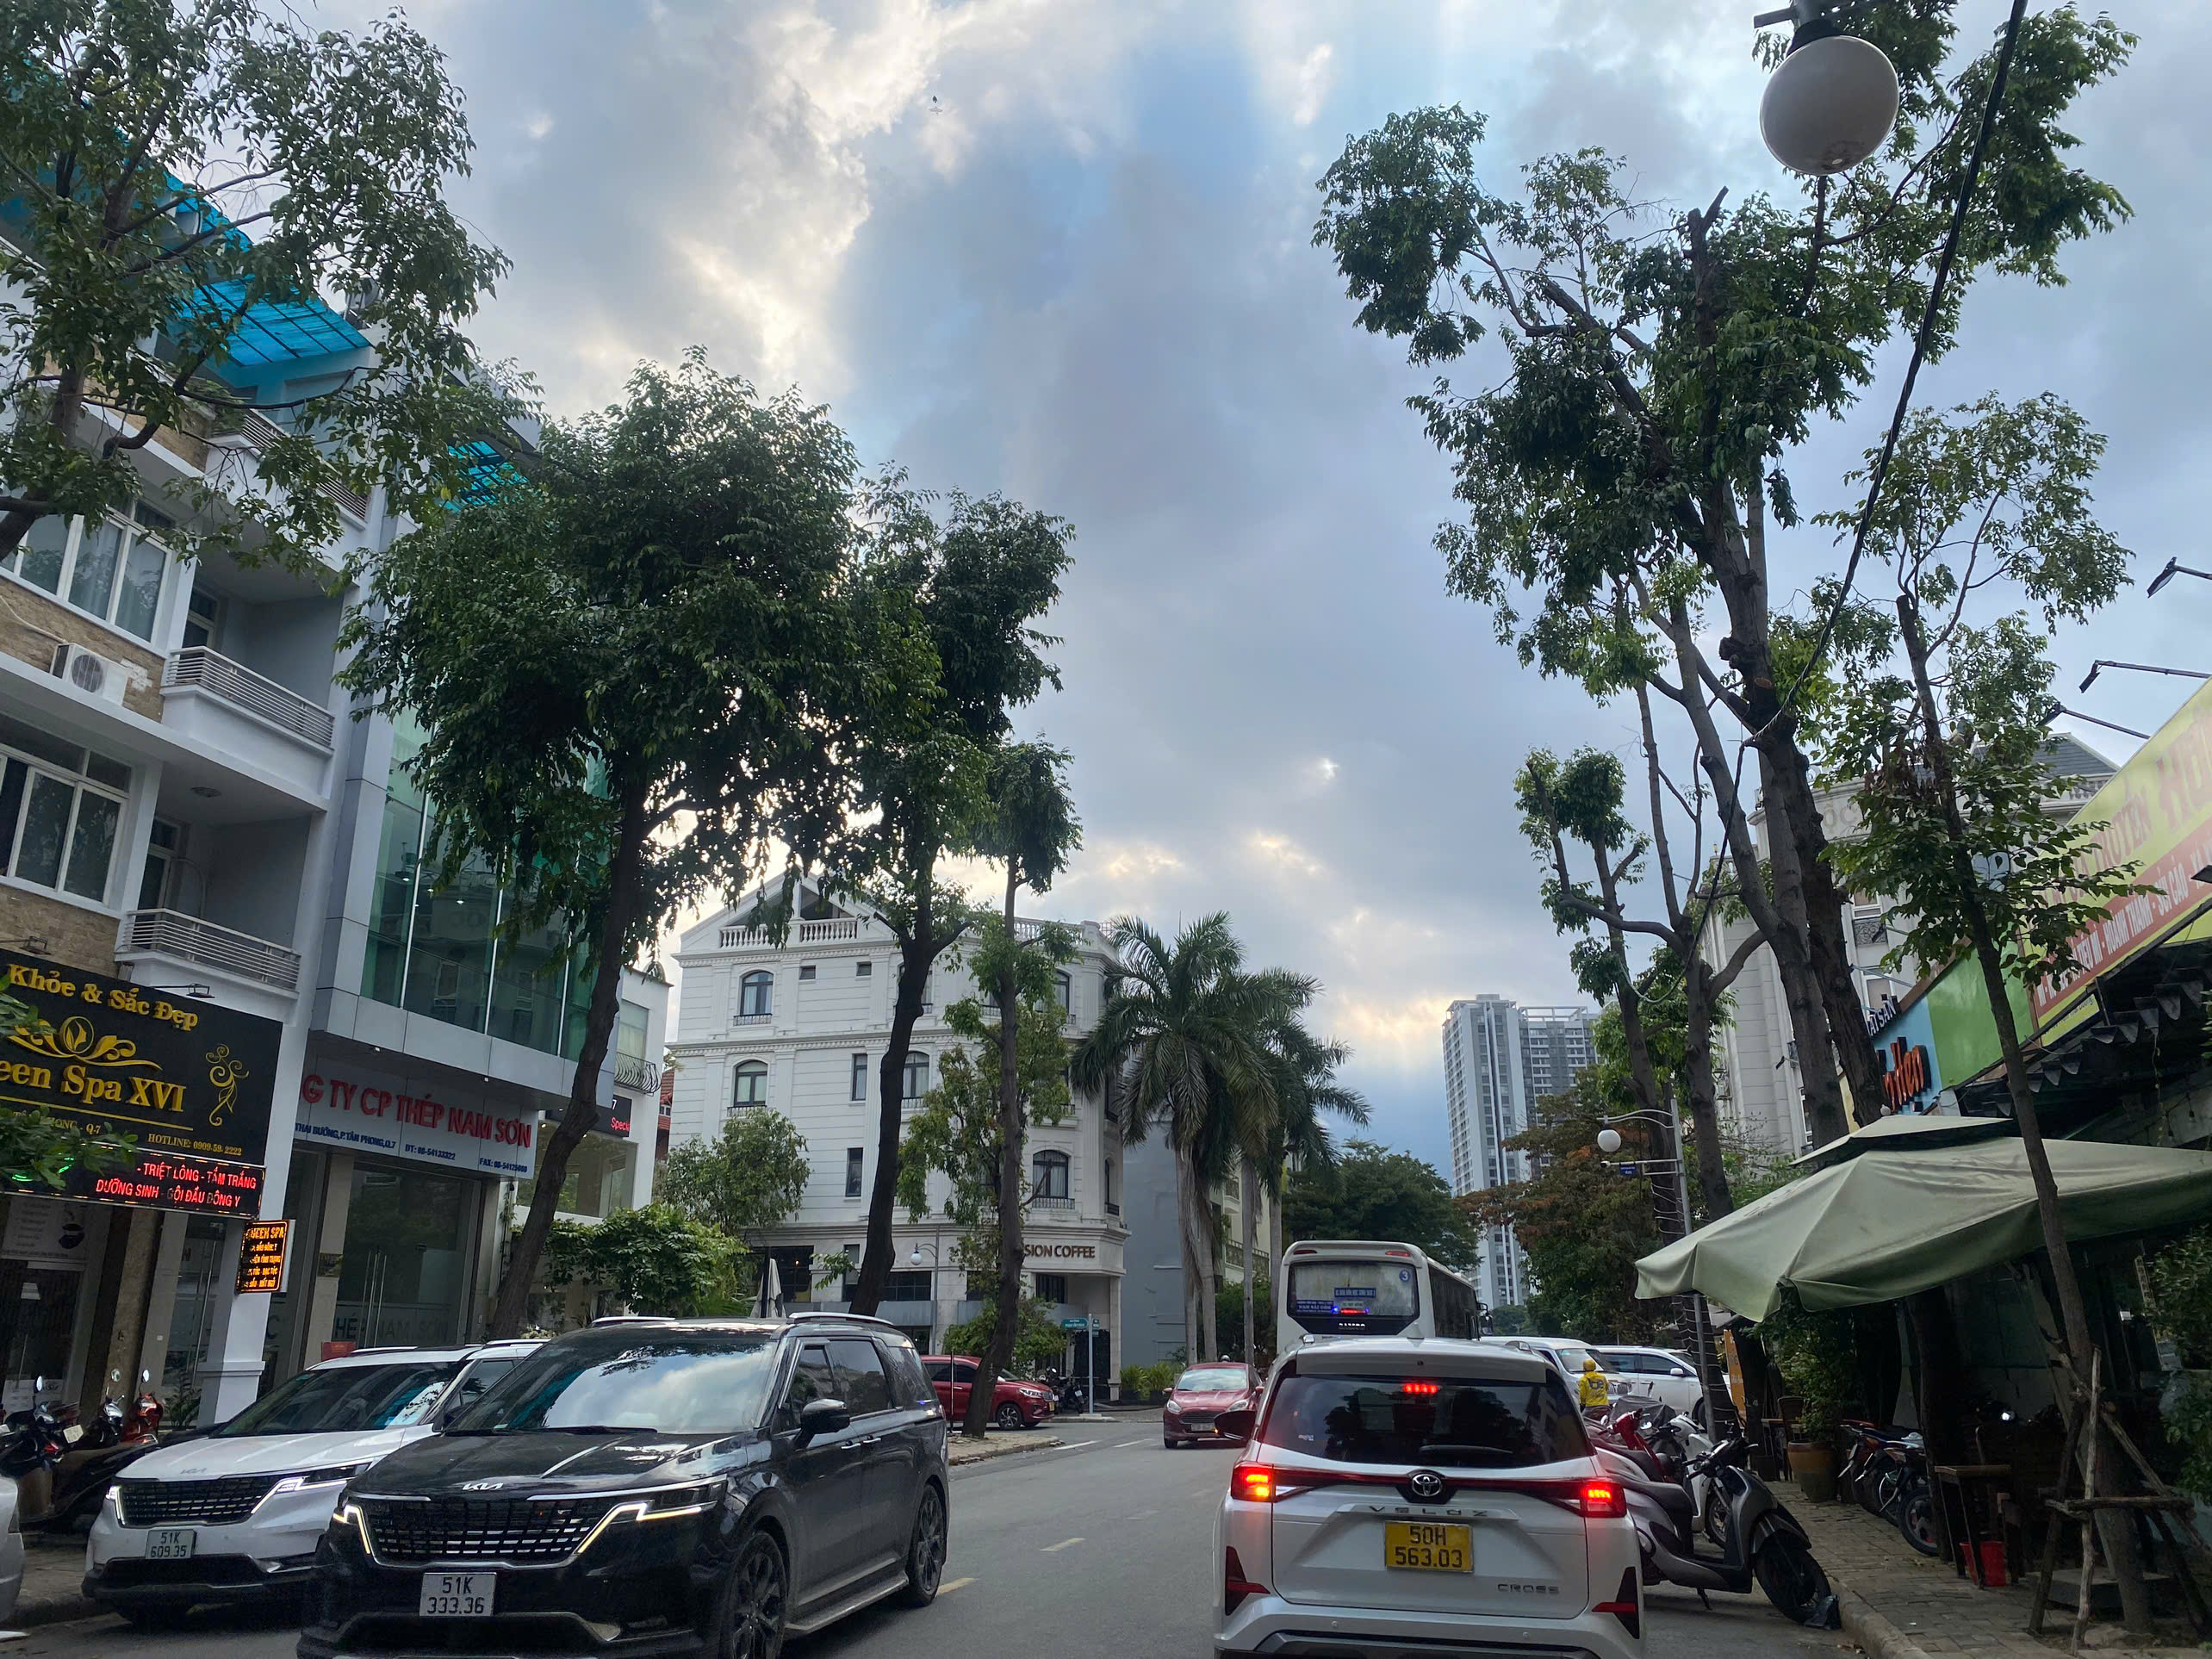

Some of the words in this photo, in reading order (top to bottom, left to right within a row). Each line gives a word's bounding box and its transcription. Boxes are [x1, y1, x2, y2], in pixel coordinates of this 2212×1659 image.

[7, 963, 76, 997] Khỏe
[83, 983, 102, 1003] &
[108, 988, 150, 1015] Sắc
[152, 1001, 198, 1032] Đẹp
[61, 1064, 121, 1105] Spa
[127, 1077, 187, 1112] XVI
[331, 1078, 358, 1111] TY
[360, 1087, 391, 1118] CP
[396, 1093, 445, 1129] THÉP
[448, 1106, 492, 1140] NAM
[494, 1117, 532, 1150] SƠN
[148, 1133, 191, 1148] HOTLINE:
[173, 1165, 199, 1182] LÔNG
[227, 1171, 257, 1189] TRẮNG
[96, 1178, 134, 1196] DƯỠNG
[134, 1184, 159, 1199] SINH
[185, 1186, 206, 1203] ĐẦU
[234, 1196, 241, 1207] Y
[1024, 1244, 1053, 1258] SION
[1054, 1245, 1096, 1258] COFFEE
[1401, 1271, 1409, 1281] 3
[1369, 1505, 1488, 1517] VELOZ
[160, 1532, 181, 1544] 51K
[1409, 1525, 1446, 1546] 50H
[150, 1545, 187, 1557] 609.35
[1395, 1546, 1463, 1568] 563.03
[442, 1576, 473, 1594] 51K
[1497, 1583, 1560, 1594] CROSS
[426, 1597, 485, 1614] 333.36
